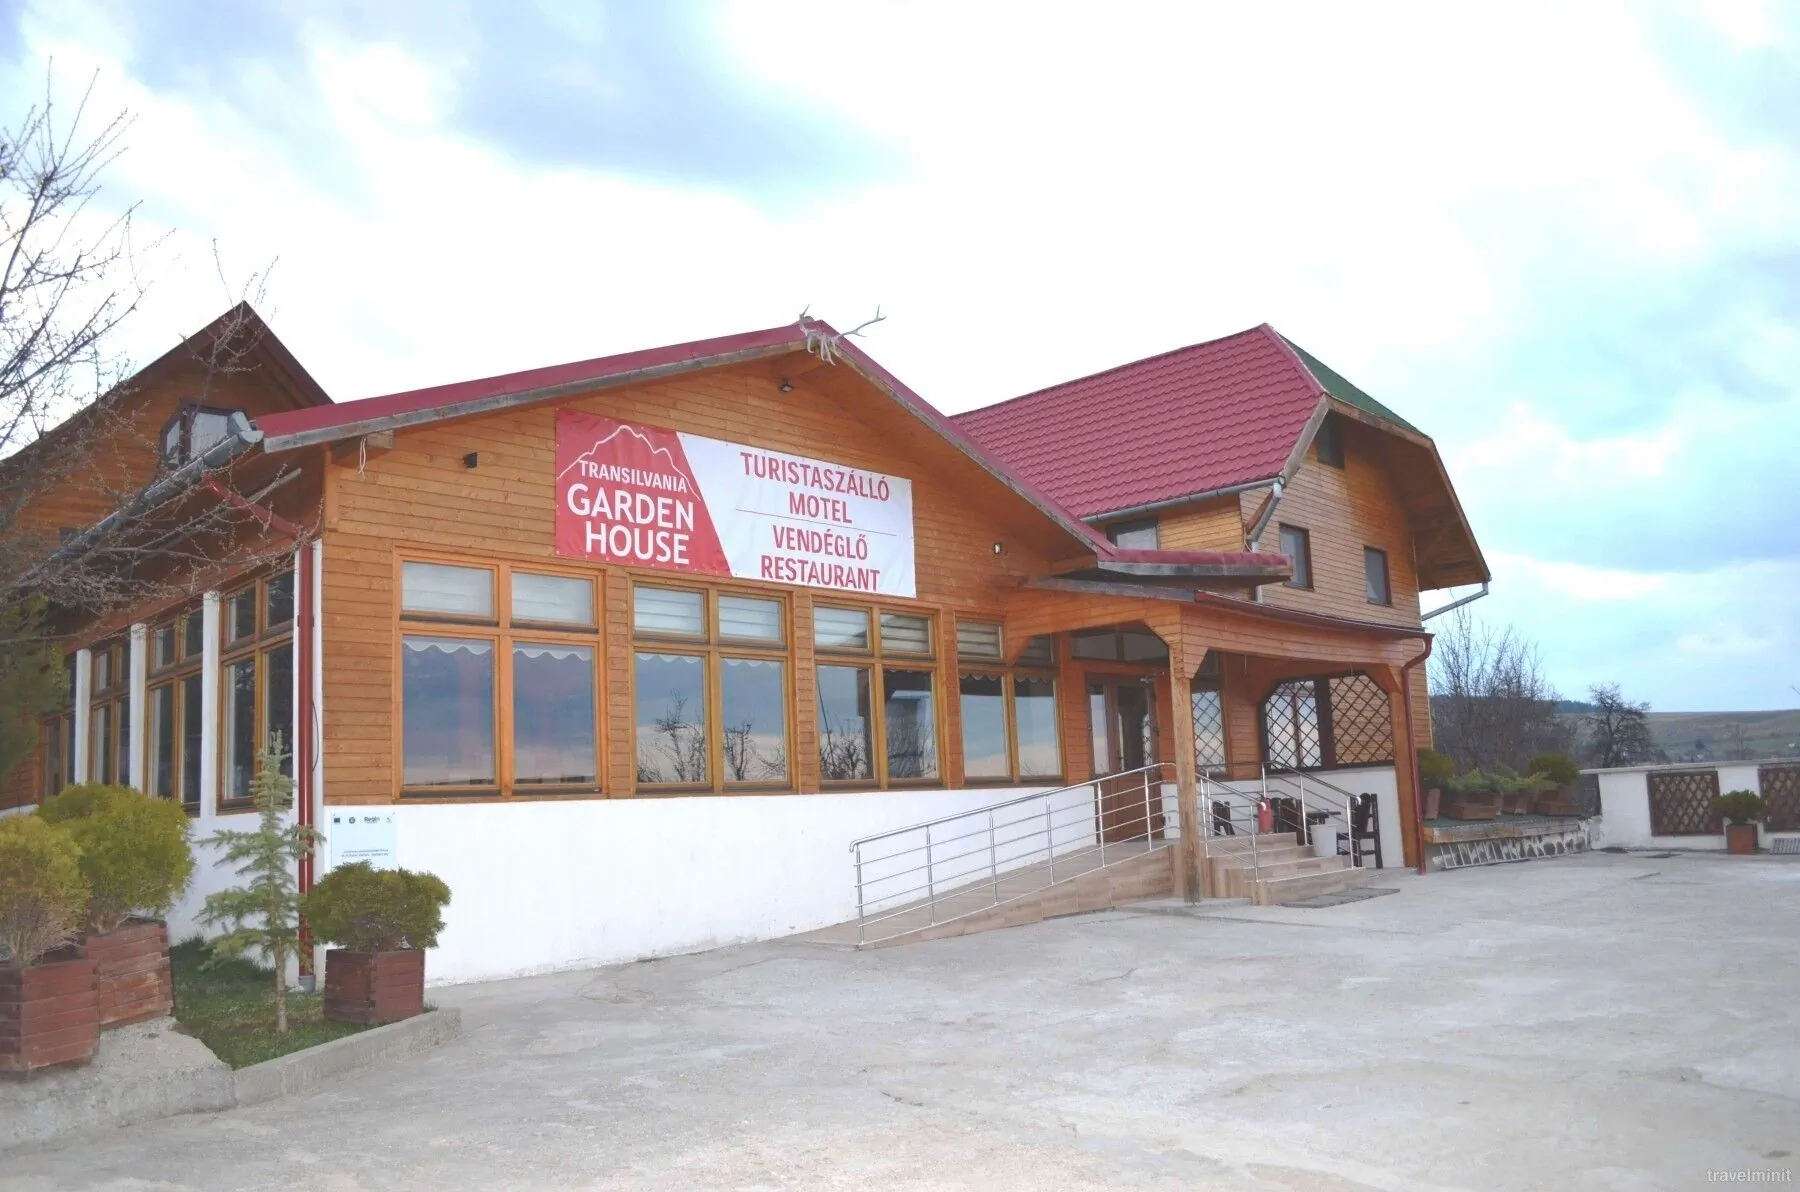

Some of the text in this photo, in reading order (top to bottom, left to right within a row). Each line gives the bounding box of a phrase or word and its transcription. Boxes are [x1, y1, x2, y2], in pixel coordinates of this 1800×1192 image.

[579, 460, 688, 493] TRANSILVANIA
[740, 452, 890, 502] TURISTASZÁLLÓ
[567, 483, 694, 532] GARDEN
[789, 491, 853, 524] MOTEL
[585, 521, 690, 565] HOUSE
[772, 525, 868, 560] VENDÉGLŐ
[760, 555, 881, 592] RESTAURANT
